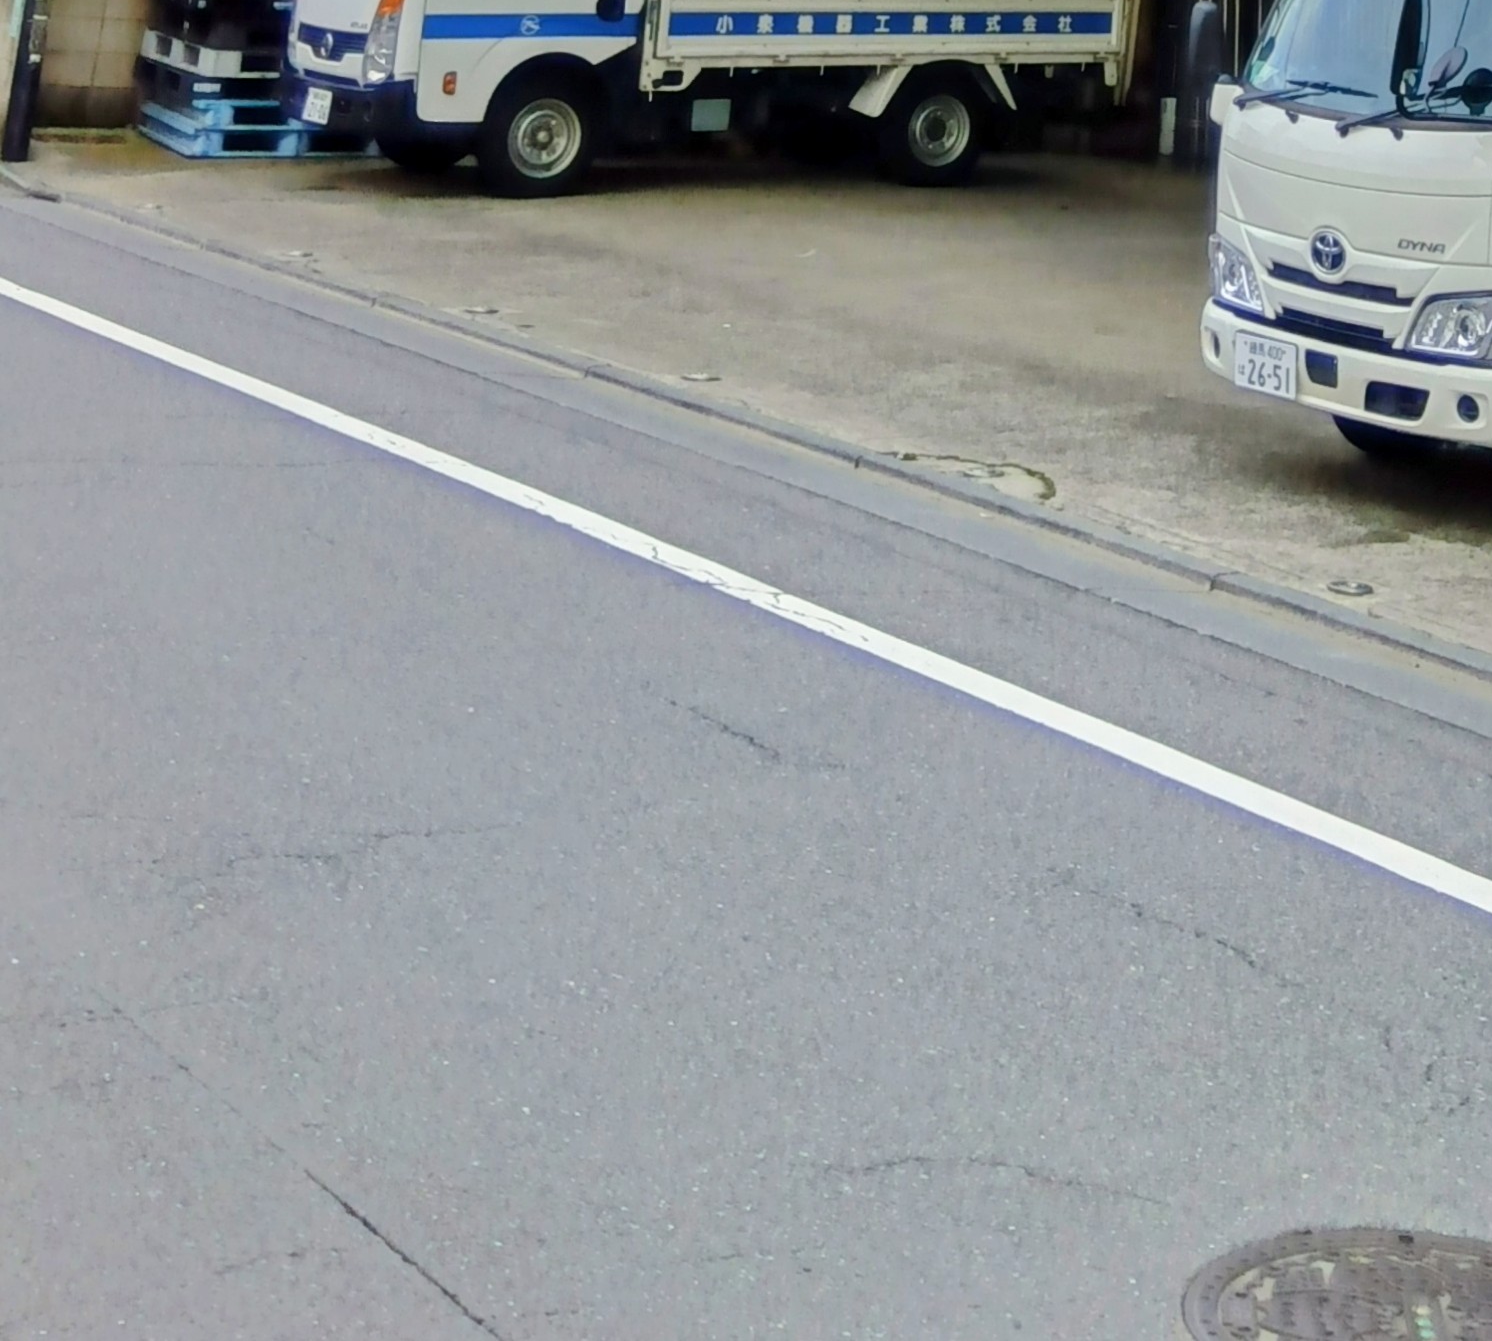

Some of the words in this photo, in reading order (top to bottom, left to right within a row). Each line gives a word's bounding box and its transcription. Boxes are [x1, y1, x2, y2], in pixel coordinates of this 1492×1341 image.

[716, 13, 1072, 34] 小泉機器工業株式会社
[1397, 238, 1446, 254] DYNA
[1247, 358, 1290, 395] 26-51
